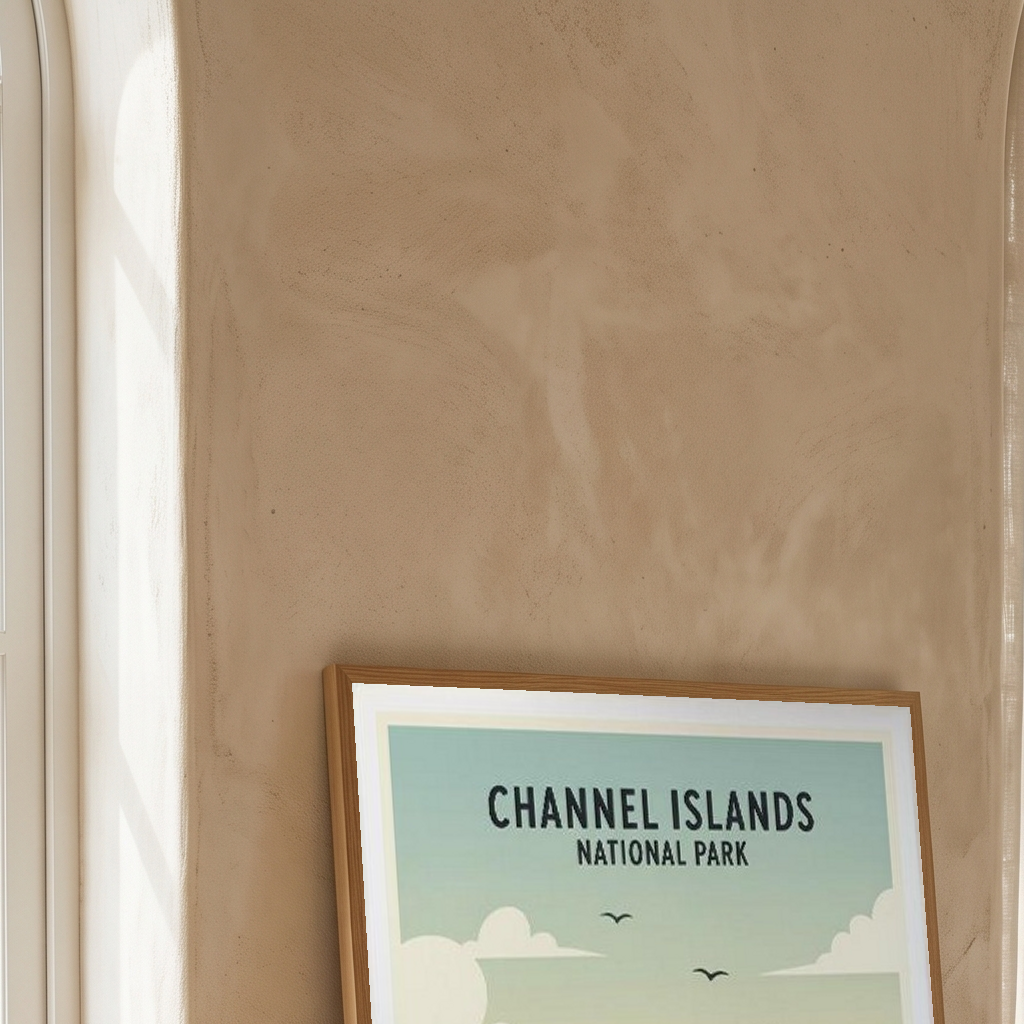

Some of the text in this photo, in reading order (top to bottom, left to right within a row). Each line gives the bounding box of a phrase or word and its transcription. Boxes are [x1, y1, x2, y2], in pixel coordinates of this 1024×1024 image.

[488, 785, 815, 833] CHANNEL ISLANDS
[577, 839, 749, 867] NATIONAL PARK
